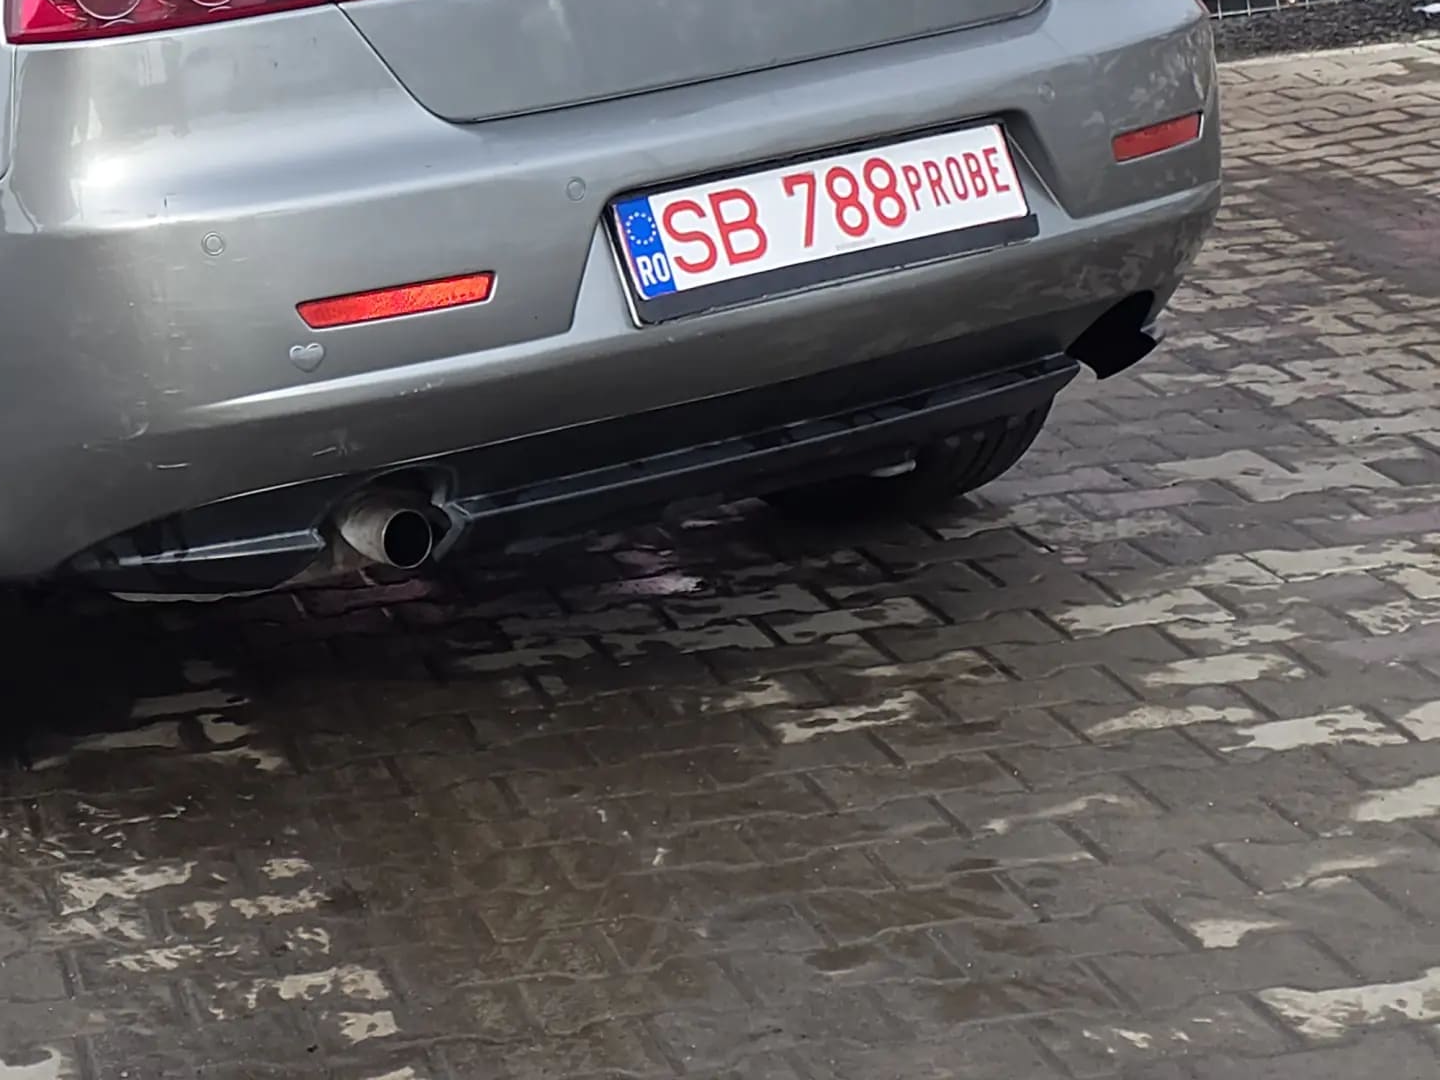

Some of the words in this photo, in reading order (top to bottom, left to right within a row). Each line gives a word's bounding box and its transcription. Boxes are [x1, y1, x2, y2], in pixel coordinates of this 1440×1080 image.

[661, 187, 768, 274] SB
[781, 156, 908, 248] 788
[901, 146, 1011, 212] PROBE
[636, 251, 671, 288] RO
